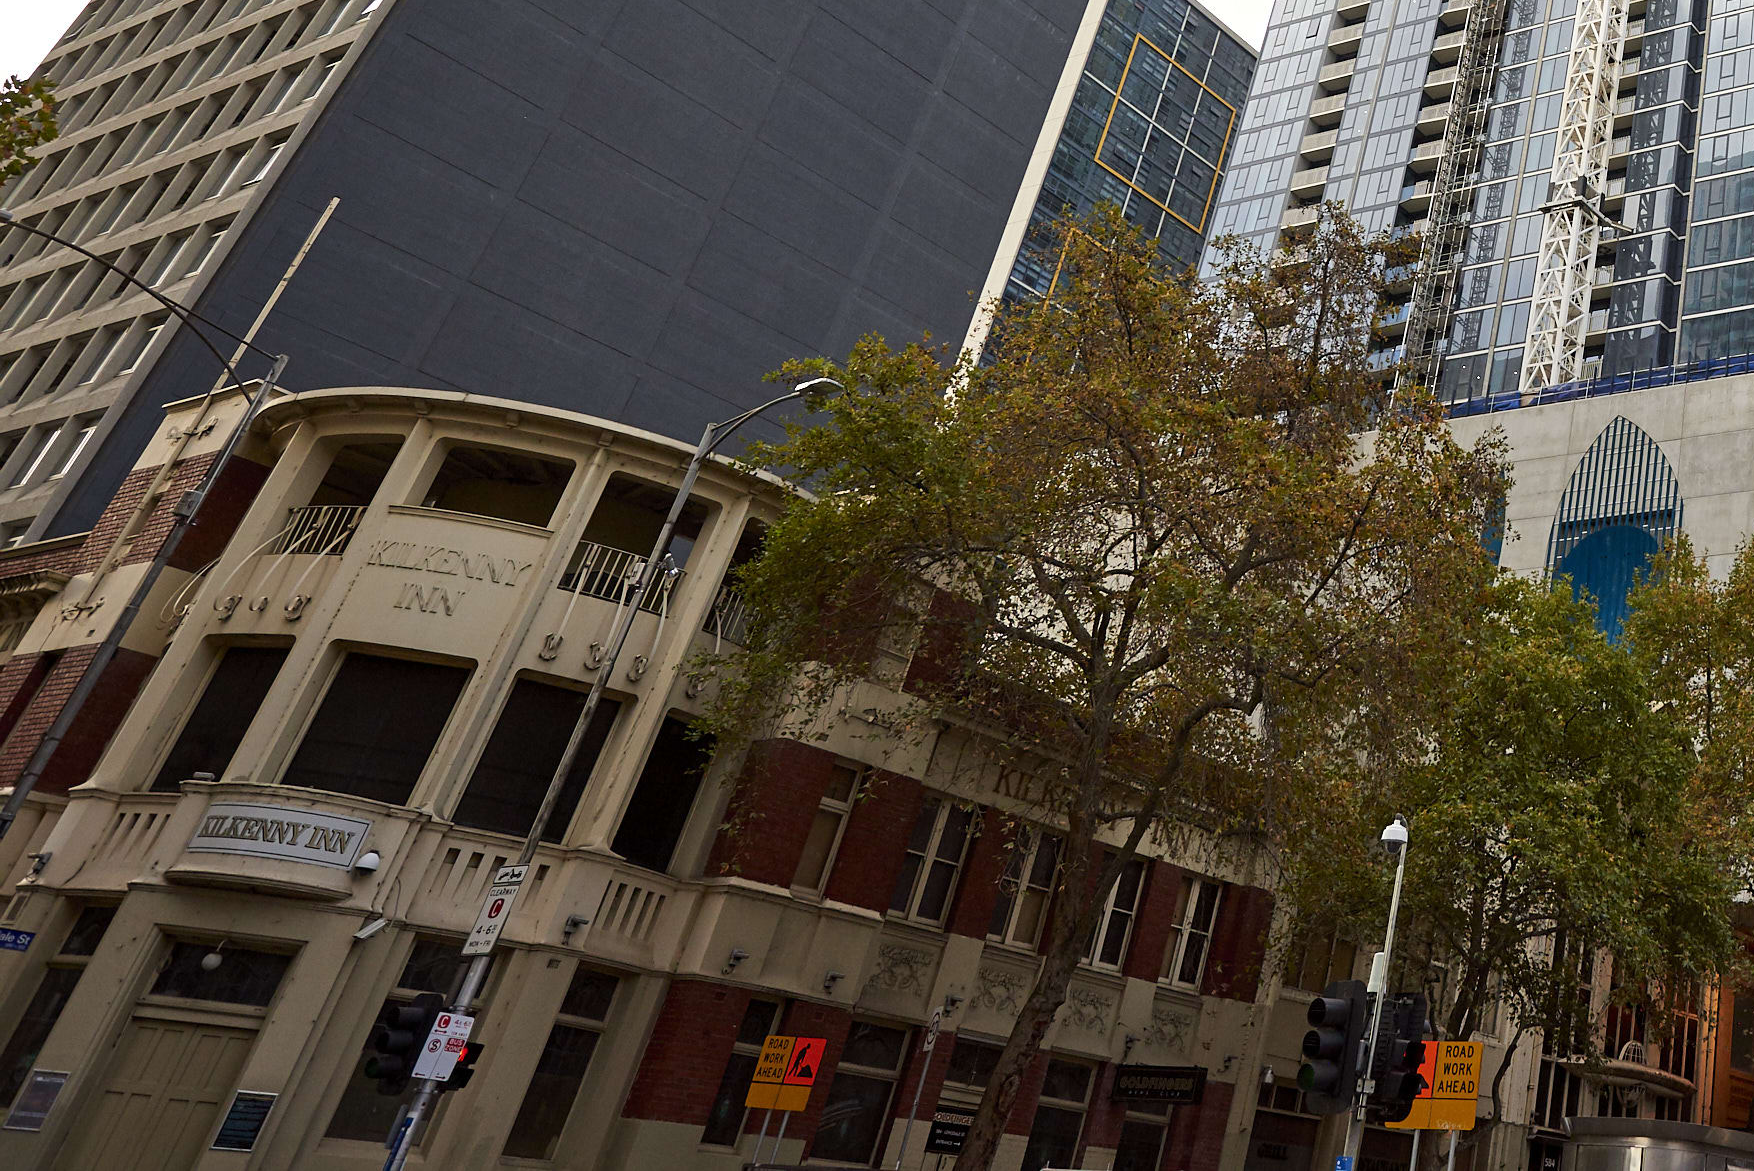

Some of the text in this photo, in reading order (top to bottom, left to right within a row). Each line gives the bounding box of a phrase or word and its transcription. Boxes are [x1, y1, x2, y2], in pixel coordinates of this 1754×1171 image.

[367, 540, 532, 587] KILKENNY
[393, 582, 466, 617] INN
[198, 815, 357, 854] KILKENNY INN
[17, 934, 30, 945] St
[449, 1038, 463, 1046] BUS
[768, 1038, 790, 1050] ROAD
[763, 1052, 786, 1064] WORK
[1445, 1045, 1474, 1058] ROAD
[756, 1066, 783, 1079] AHEAD
[1443, 1062, 1472, 1075] WORK
[1119, 1076, 1194, 1091] GOLDFINGERS
[1437, 1080, 1475, 1093] AHEAD
[933, 1111, 976, 1127] GOLDFINGE
